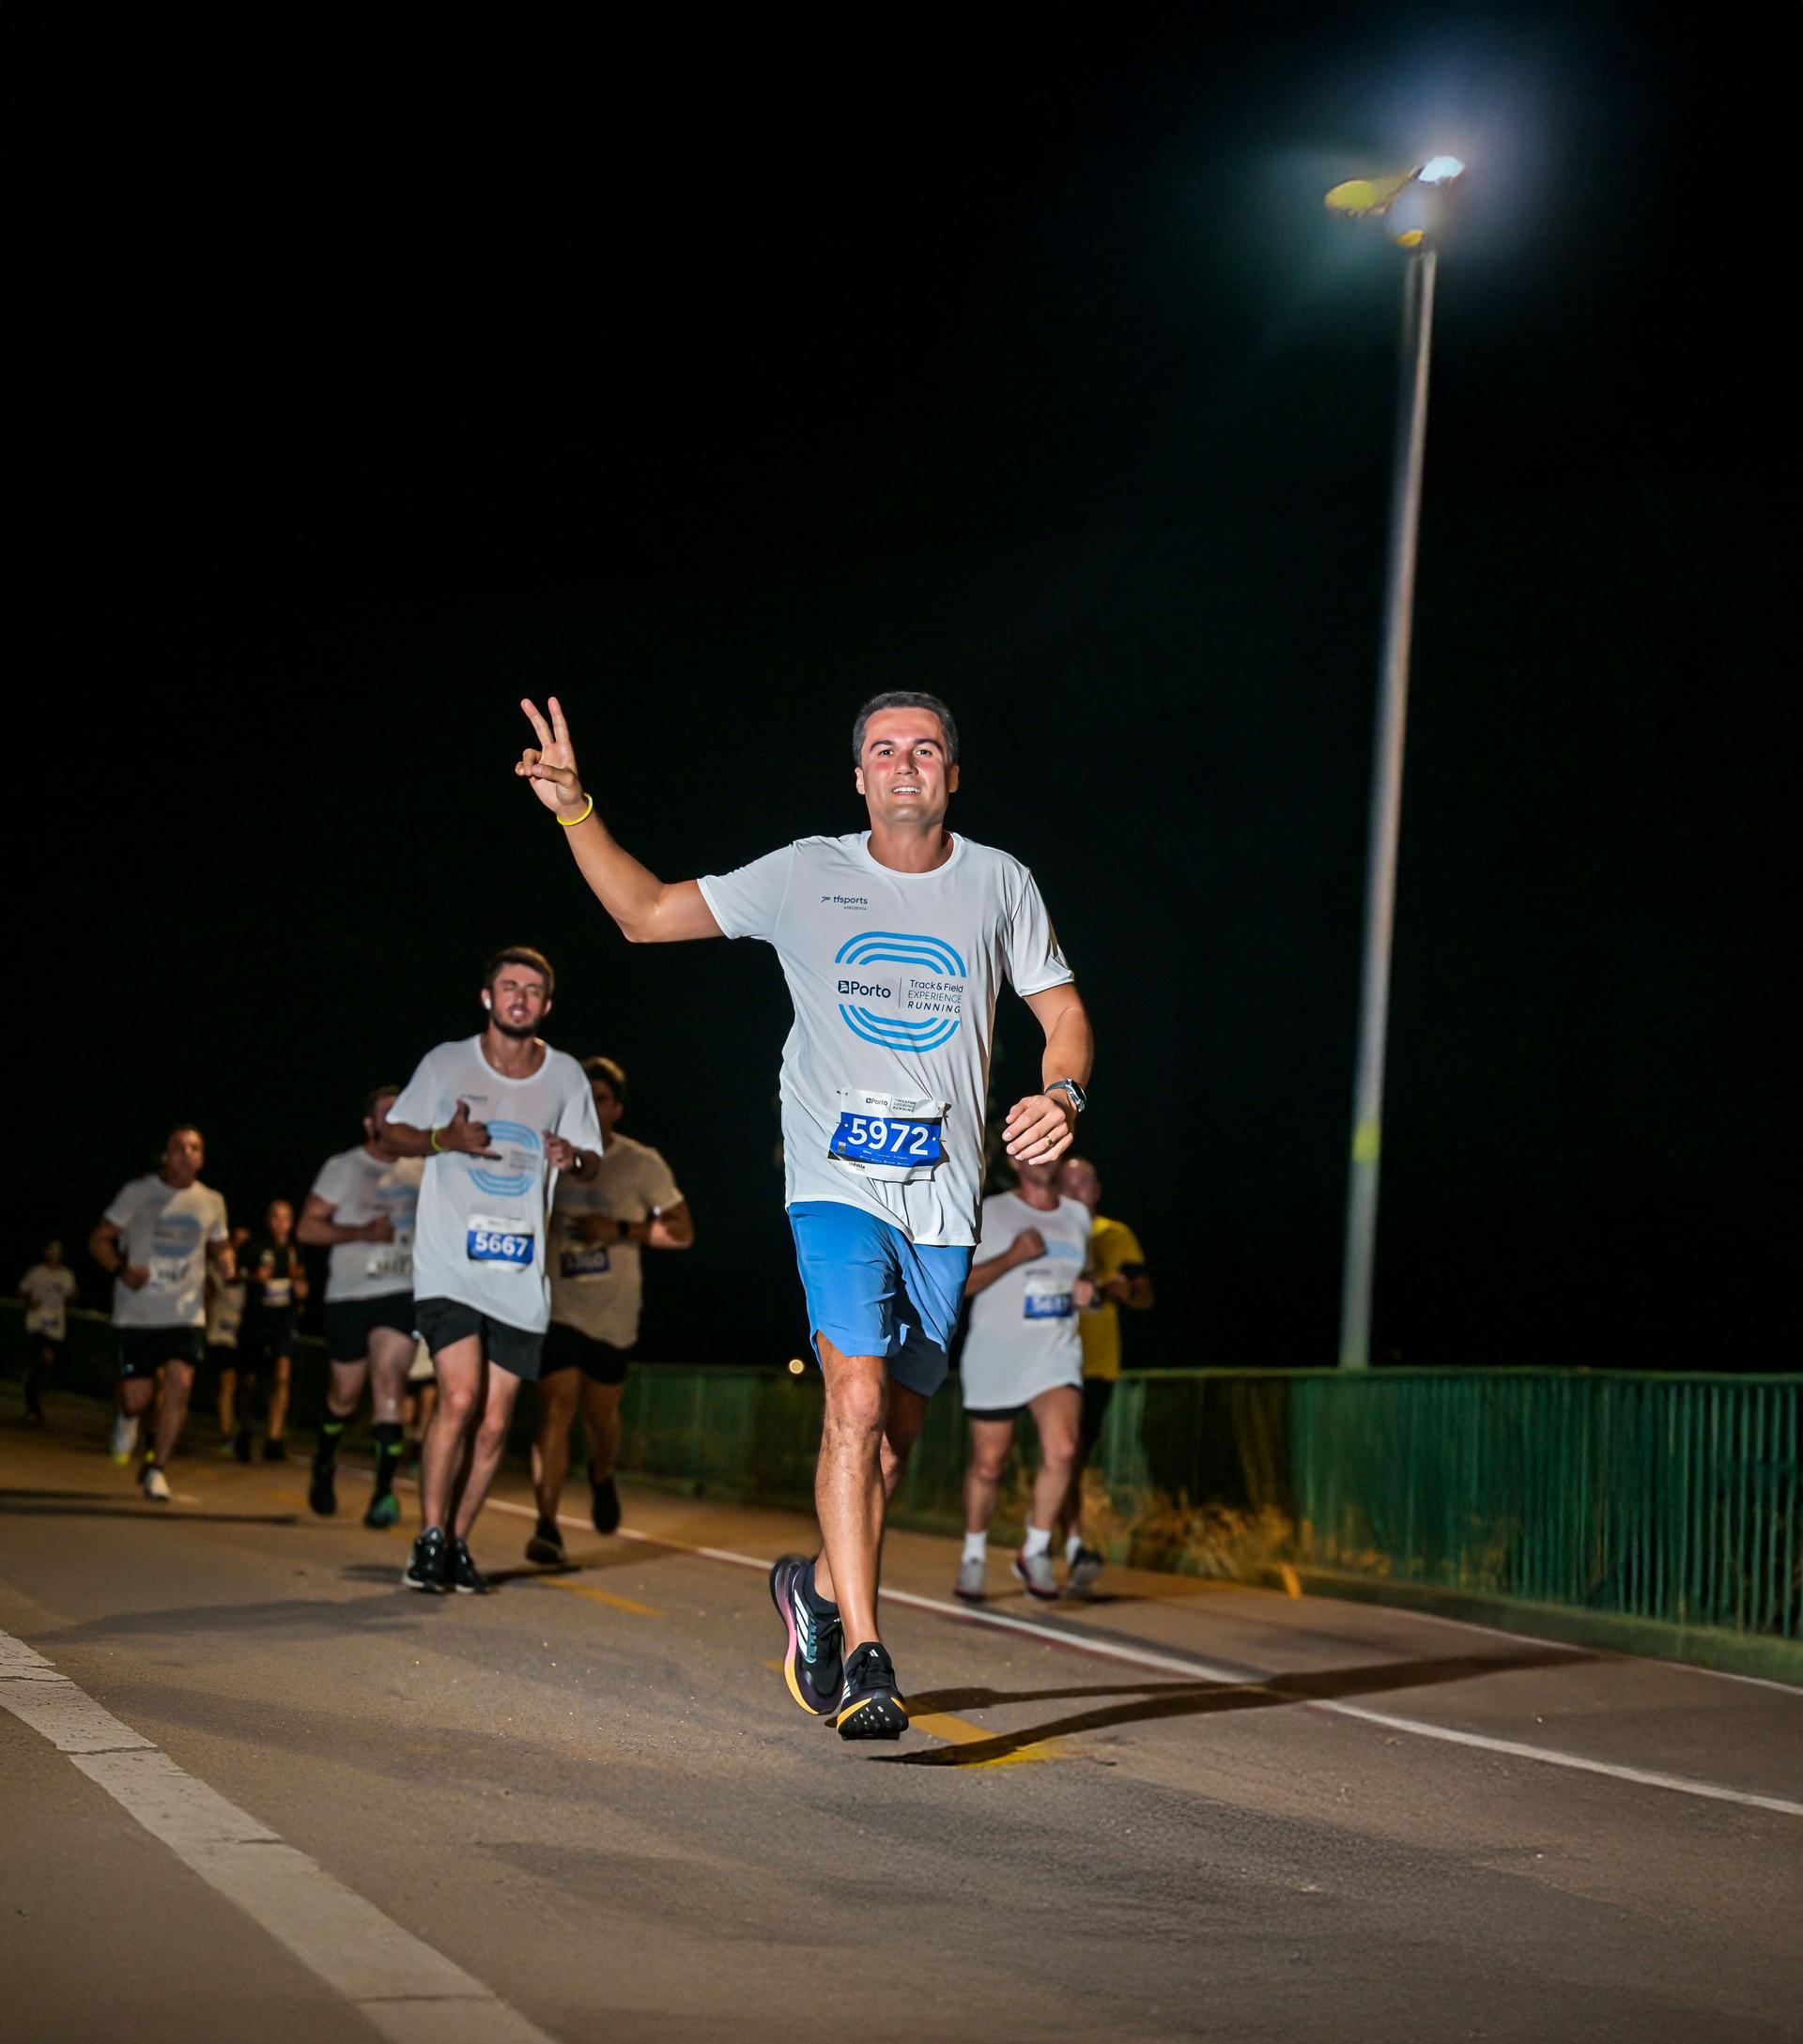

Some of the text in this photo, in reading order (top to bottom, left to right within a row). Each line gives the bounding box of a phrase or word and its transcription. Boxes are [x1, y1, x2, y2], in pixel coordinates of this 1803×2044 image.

[833, 895, 869, 905] tfsports
[851, 980, 891, 998] Porto
[907, 991, 963, 1004] EXPERIENCE
[907, 1001, 961, 1014] RUNNING
[871, 1098, 888, 1106] Porto
[847, 1117, 929, 1156] 5972
[475, 1232, 528, 1257] 5667
